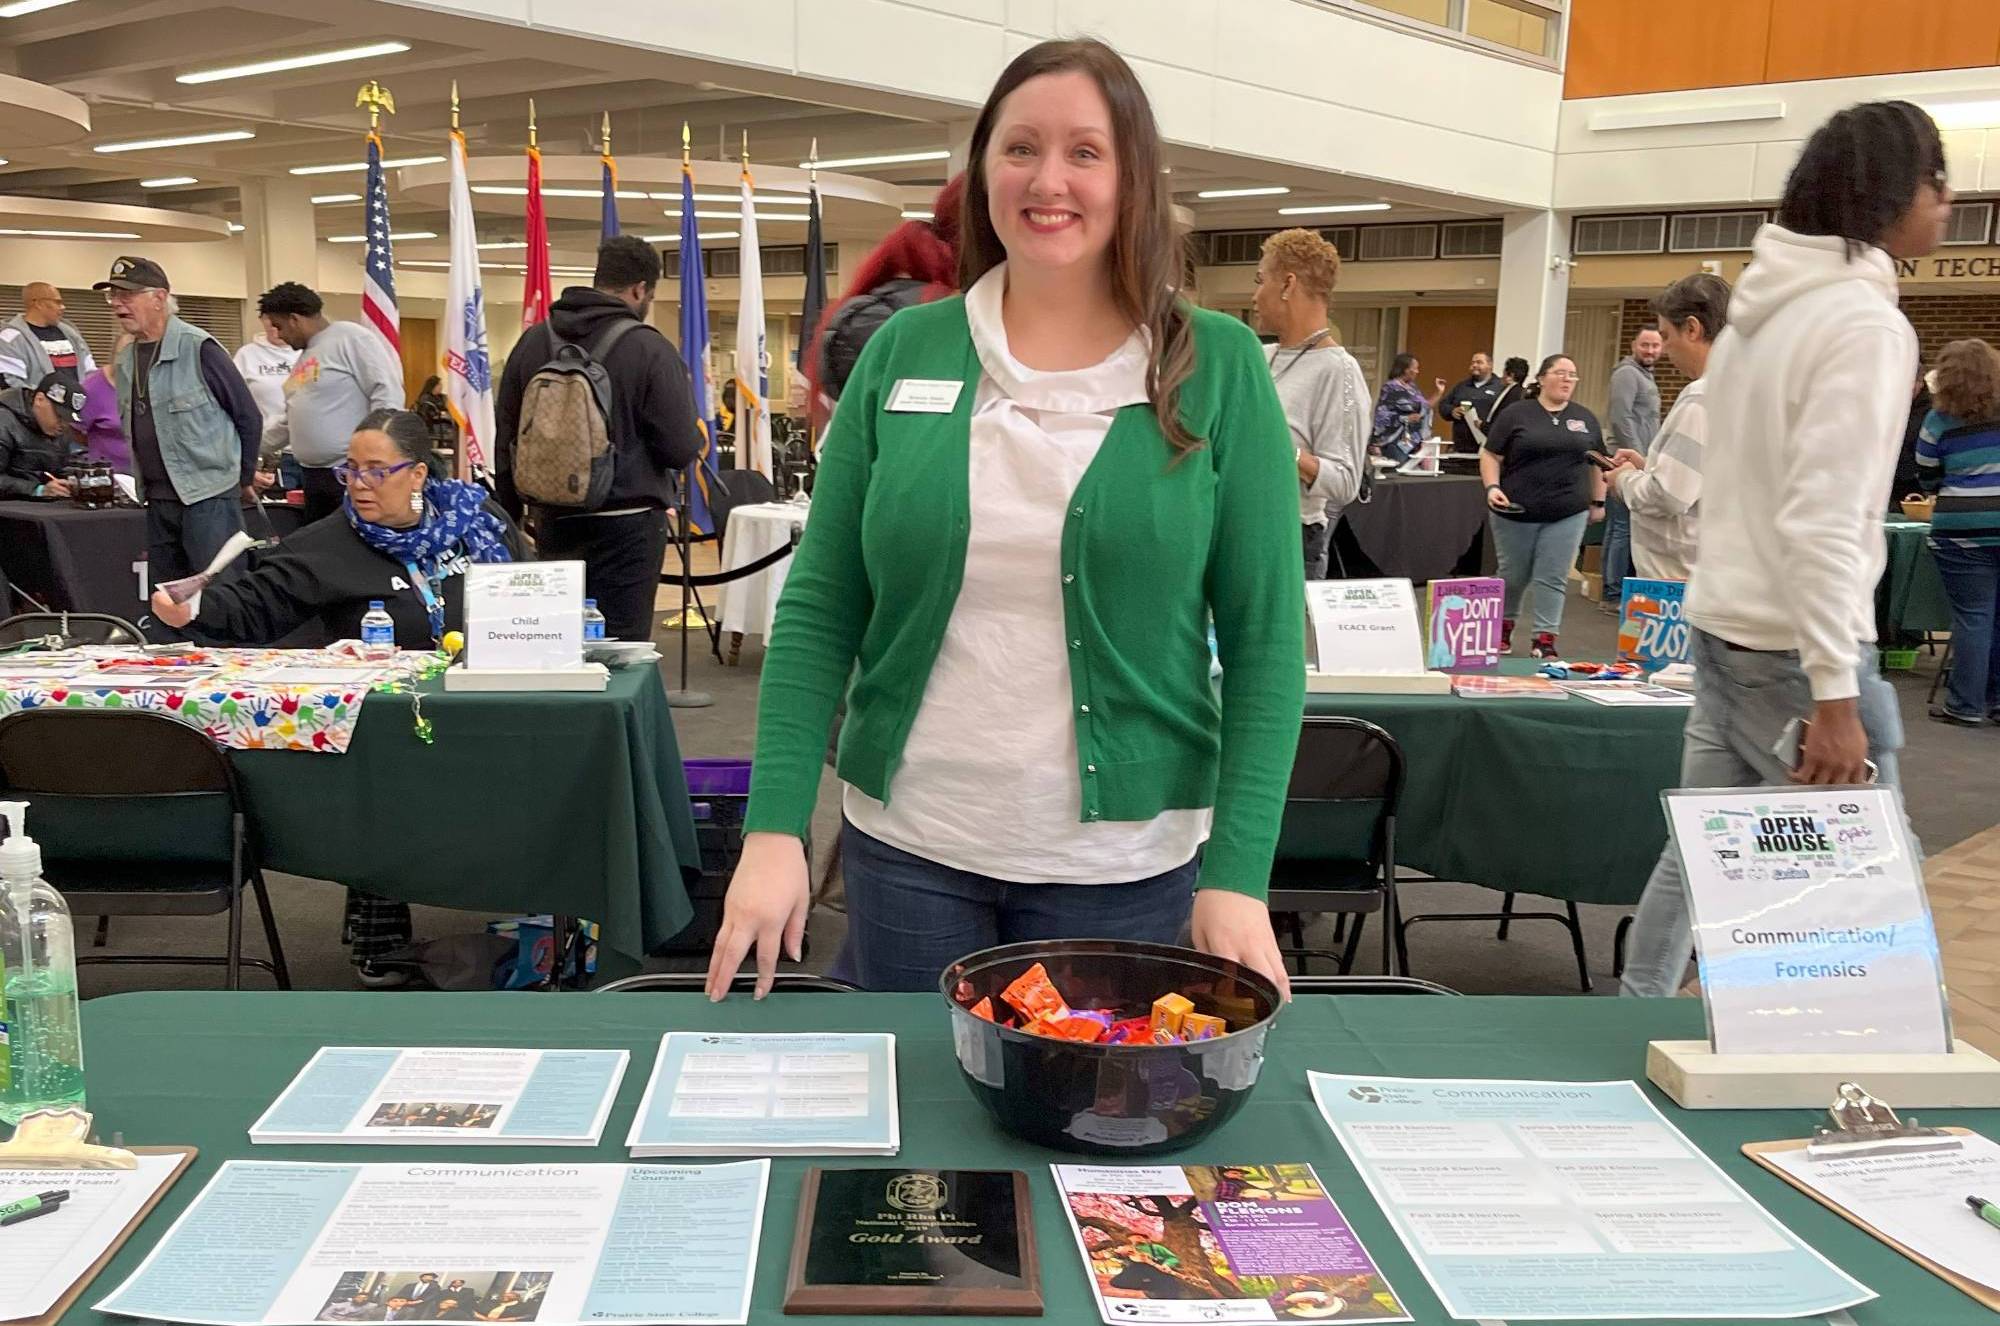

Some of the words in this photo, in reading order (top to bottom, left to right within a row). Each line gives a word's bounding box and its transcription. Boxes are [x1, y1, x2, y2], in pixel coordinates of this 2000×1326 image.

[511, 616, 539, 625] Child
[488, 631, 562, 641] Development
[1446, 620, 1498, 656] YELL
[1760, 816, 1816, 834] OPEN
[1756, 833, 1831, 852] HOUSE
[1732, 924, 1896, 947] Communication/
[1775, 961, 1867, 978] Forensics
[421, 1049, 527, 1057] Communication
[1432, 1088, 1593, 1099] Communication
[407, 1167, 580, 1177] Communication
[877, 1212, 902, 1220] Phi
[848, 1232, 905, 1243] Gold
[907, 1234, 984, 1244] Award
